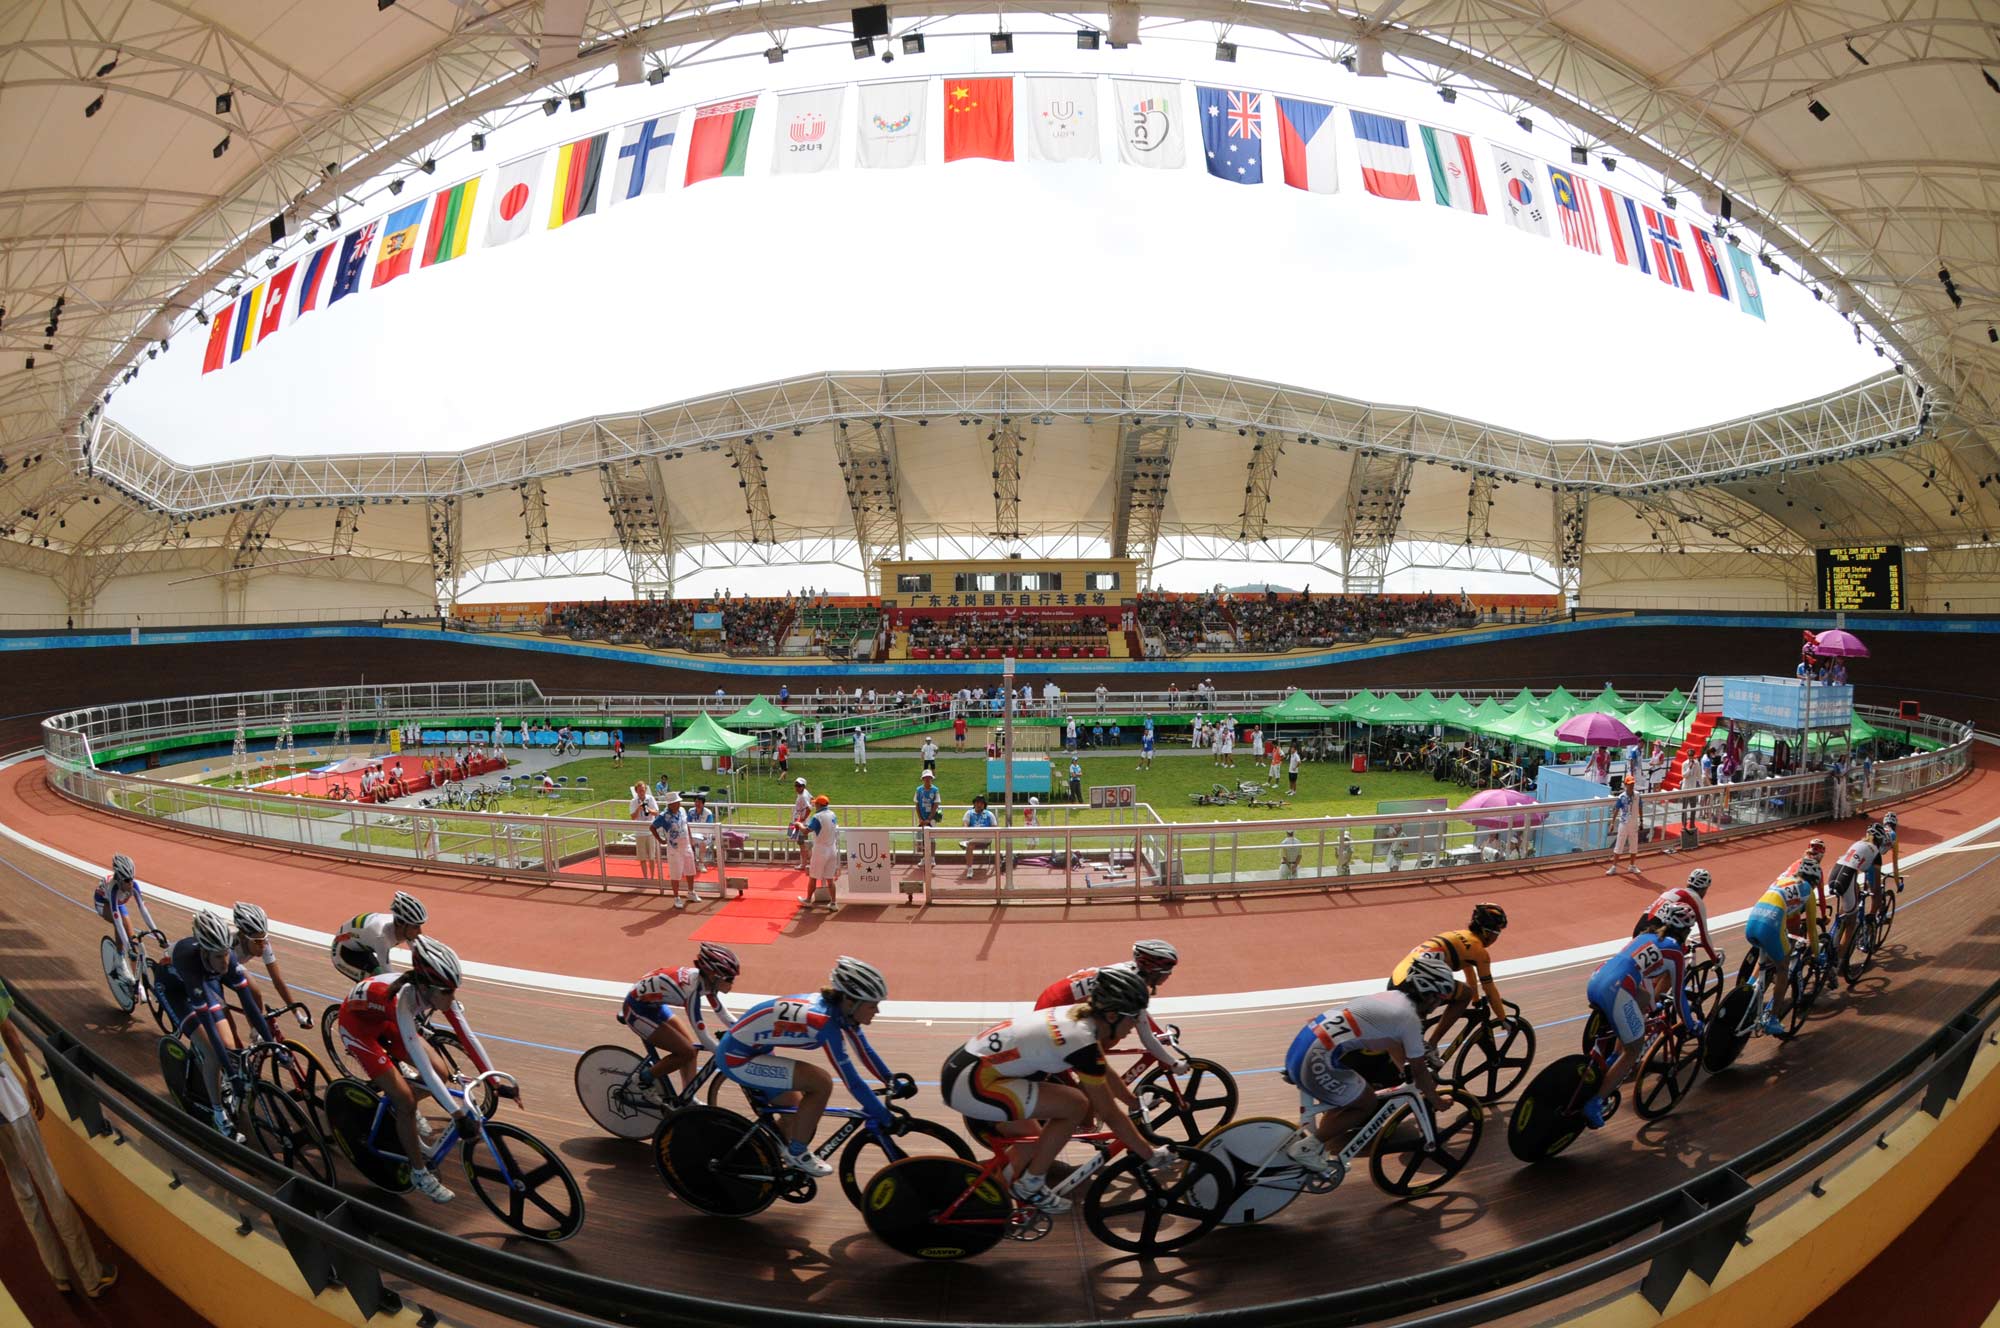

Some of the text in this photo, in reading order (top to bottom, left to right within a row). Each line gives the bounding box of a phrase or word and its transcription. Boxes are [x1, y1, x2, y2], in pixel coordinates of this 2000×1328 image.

[911, 593, 1106, 607] 广东龙岗国际自行车赛场
[1106, 787, 1130, 800] 30
[1638, 946, 1660, 969] 25
[639, 977, 656, 994] 31
[778, 1001, 804, 1022] 27
[753, 1028, 811, 1042] ITRA
[1322, 1015, 1352, 1039] 21
[988, 1032, 1003, 1053] 8
[1311, 1046, 1347, 1096] KOREA
[819, 1124, 854, 1158] ARELLO
[1343, 1102, 1398, 1159] TESCHNER
